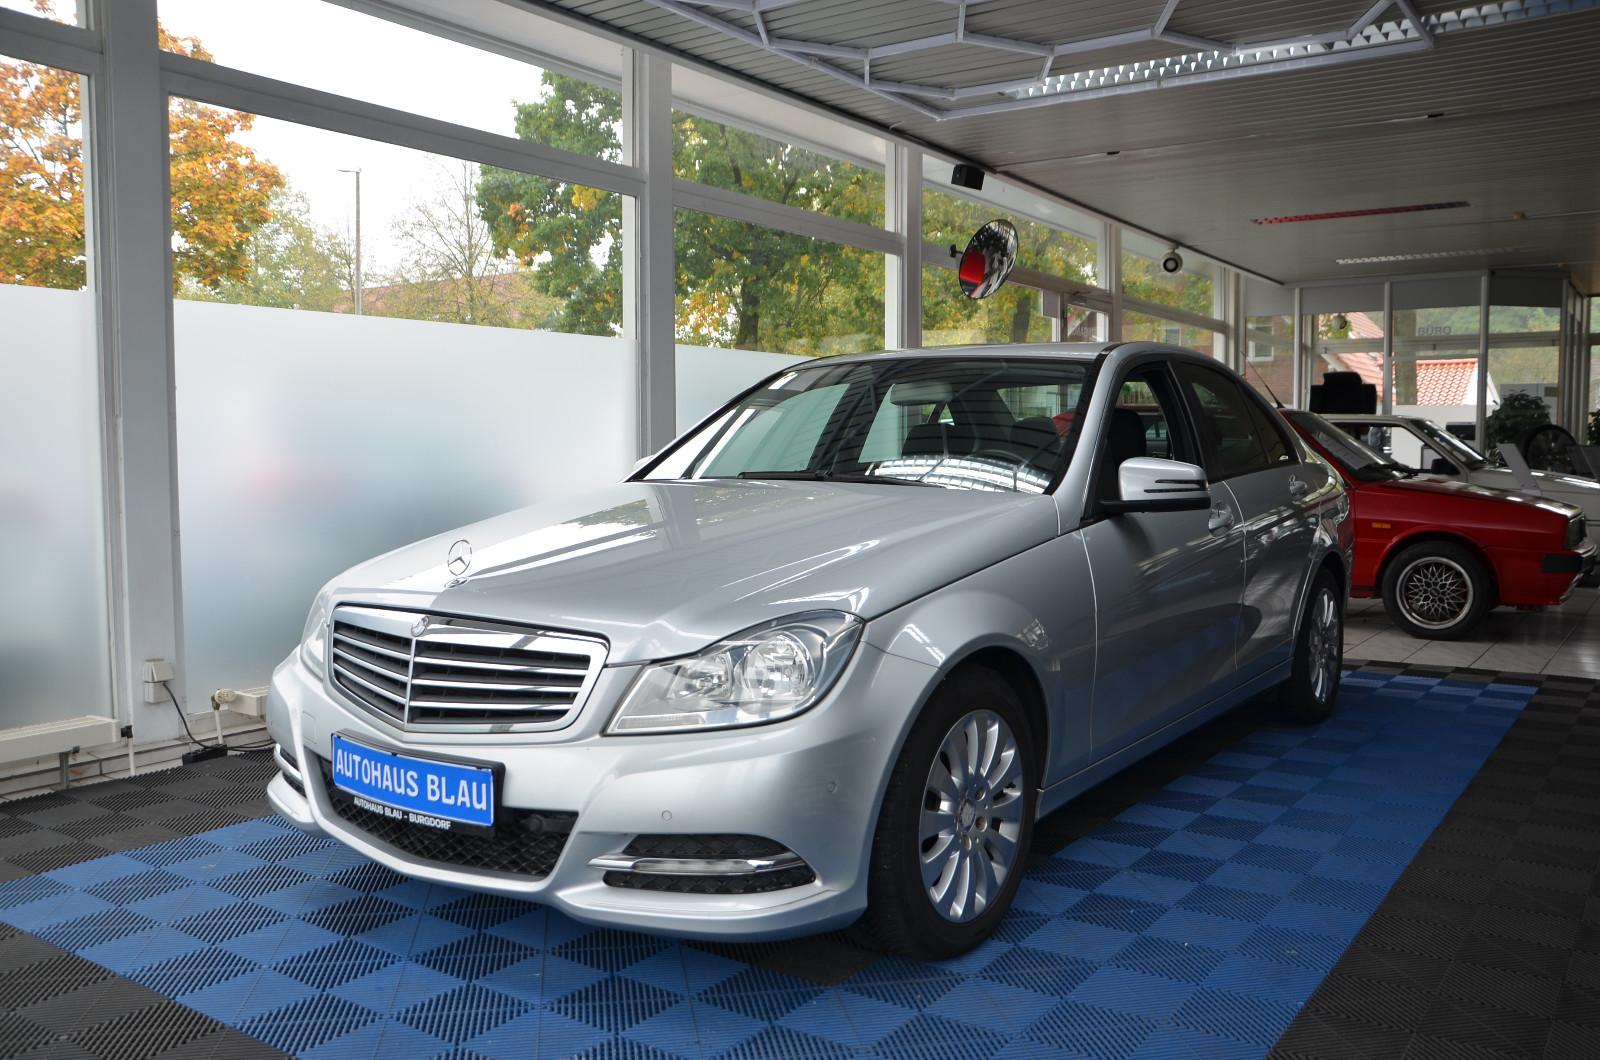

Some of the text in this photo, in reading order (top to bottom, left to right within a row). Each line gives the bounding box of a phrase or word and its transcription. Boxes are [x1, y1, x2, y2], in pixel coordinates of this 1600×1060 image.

[336, 748, 487, 811] AUTOHAUS BLAU
[353, 796, 384, 814] AUTOHAUS
[384, 806, 403, 819] BLAU
[408, 813, 451, 830] BURGDORF
